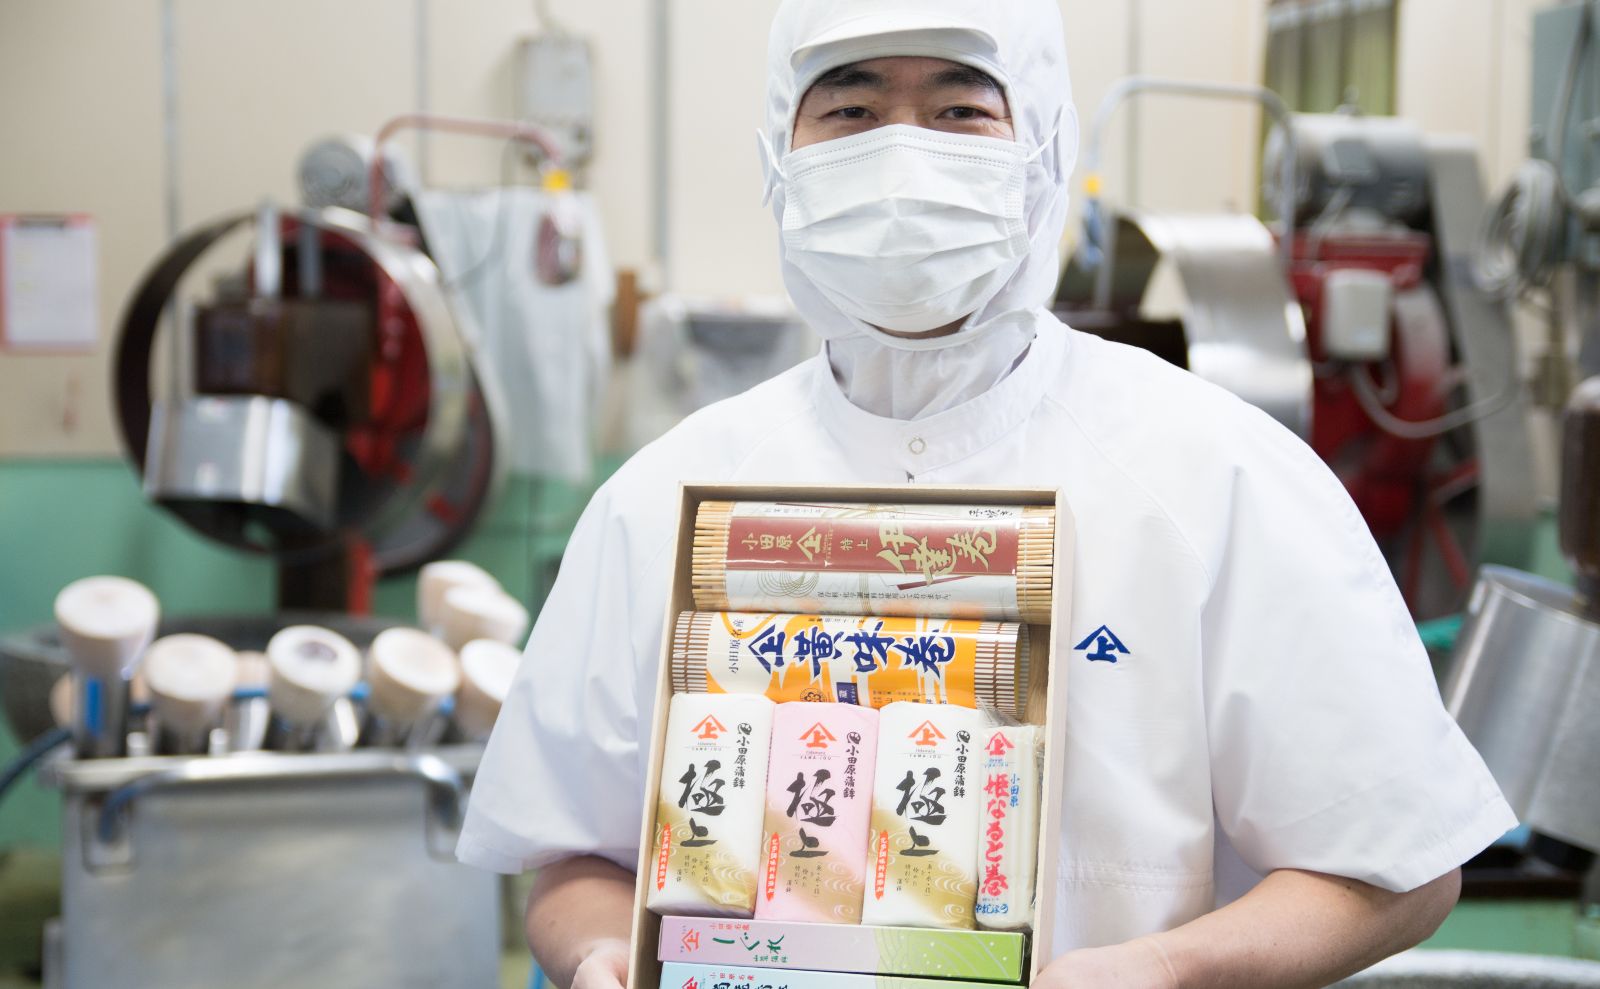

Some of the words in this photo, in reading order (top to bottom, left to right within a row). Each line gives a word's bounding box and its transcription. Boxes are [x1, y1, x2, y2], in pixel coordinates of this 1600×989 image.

[741, 532, 793, 551] 小田原
[840, 537, 869, 551] 特上
[876, 521, 997, 586] 伊達巻
[728, 619, 744, 674] 小田原名産
[733, 736, 750, 789] 小田原蒲鉾
[843, 745, 860, 799] 小田原蒲鉾
[953, 744, 969, 798] 小田原蒲鉾
[678, 759, 726, 847] 極上
[786, 769, 836, 858] 極上
[896, 767, 947, 857] 極上
[1010, 773, 1020, 807] 小田原
[981, 773, 1010, 897] 姫なると巻
[712, 932, 785, 954] しぐれ
[710, 972, 754, 981] 小田原名産
